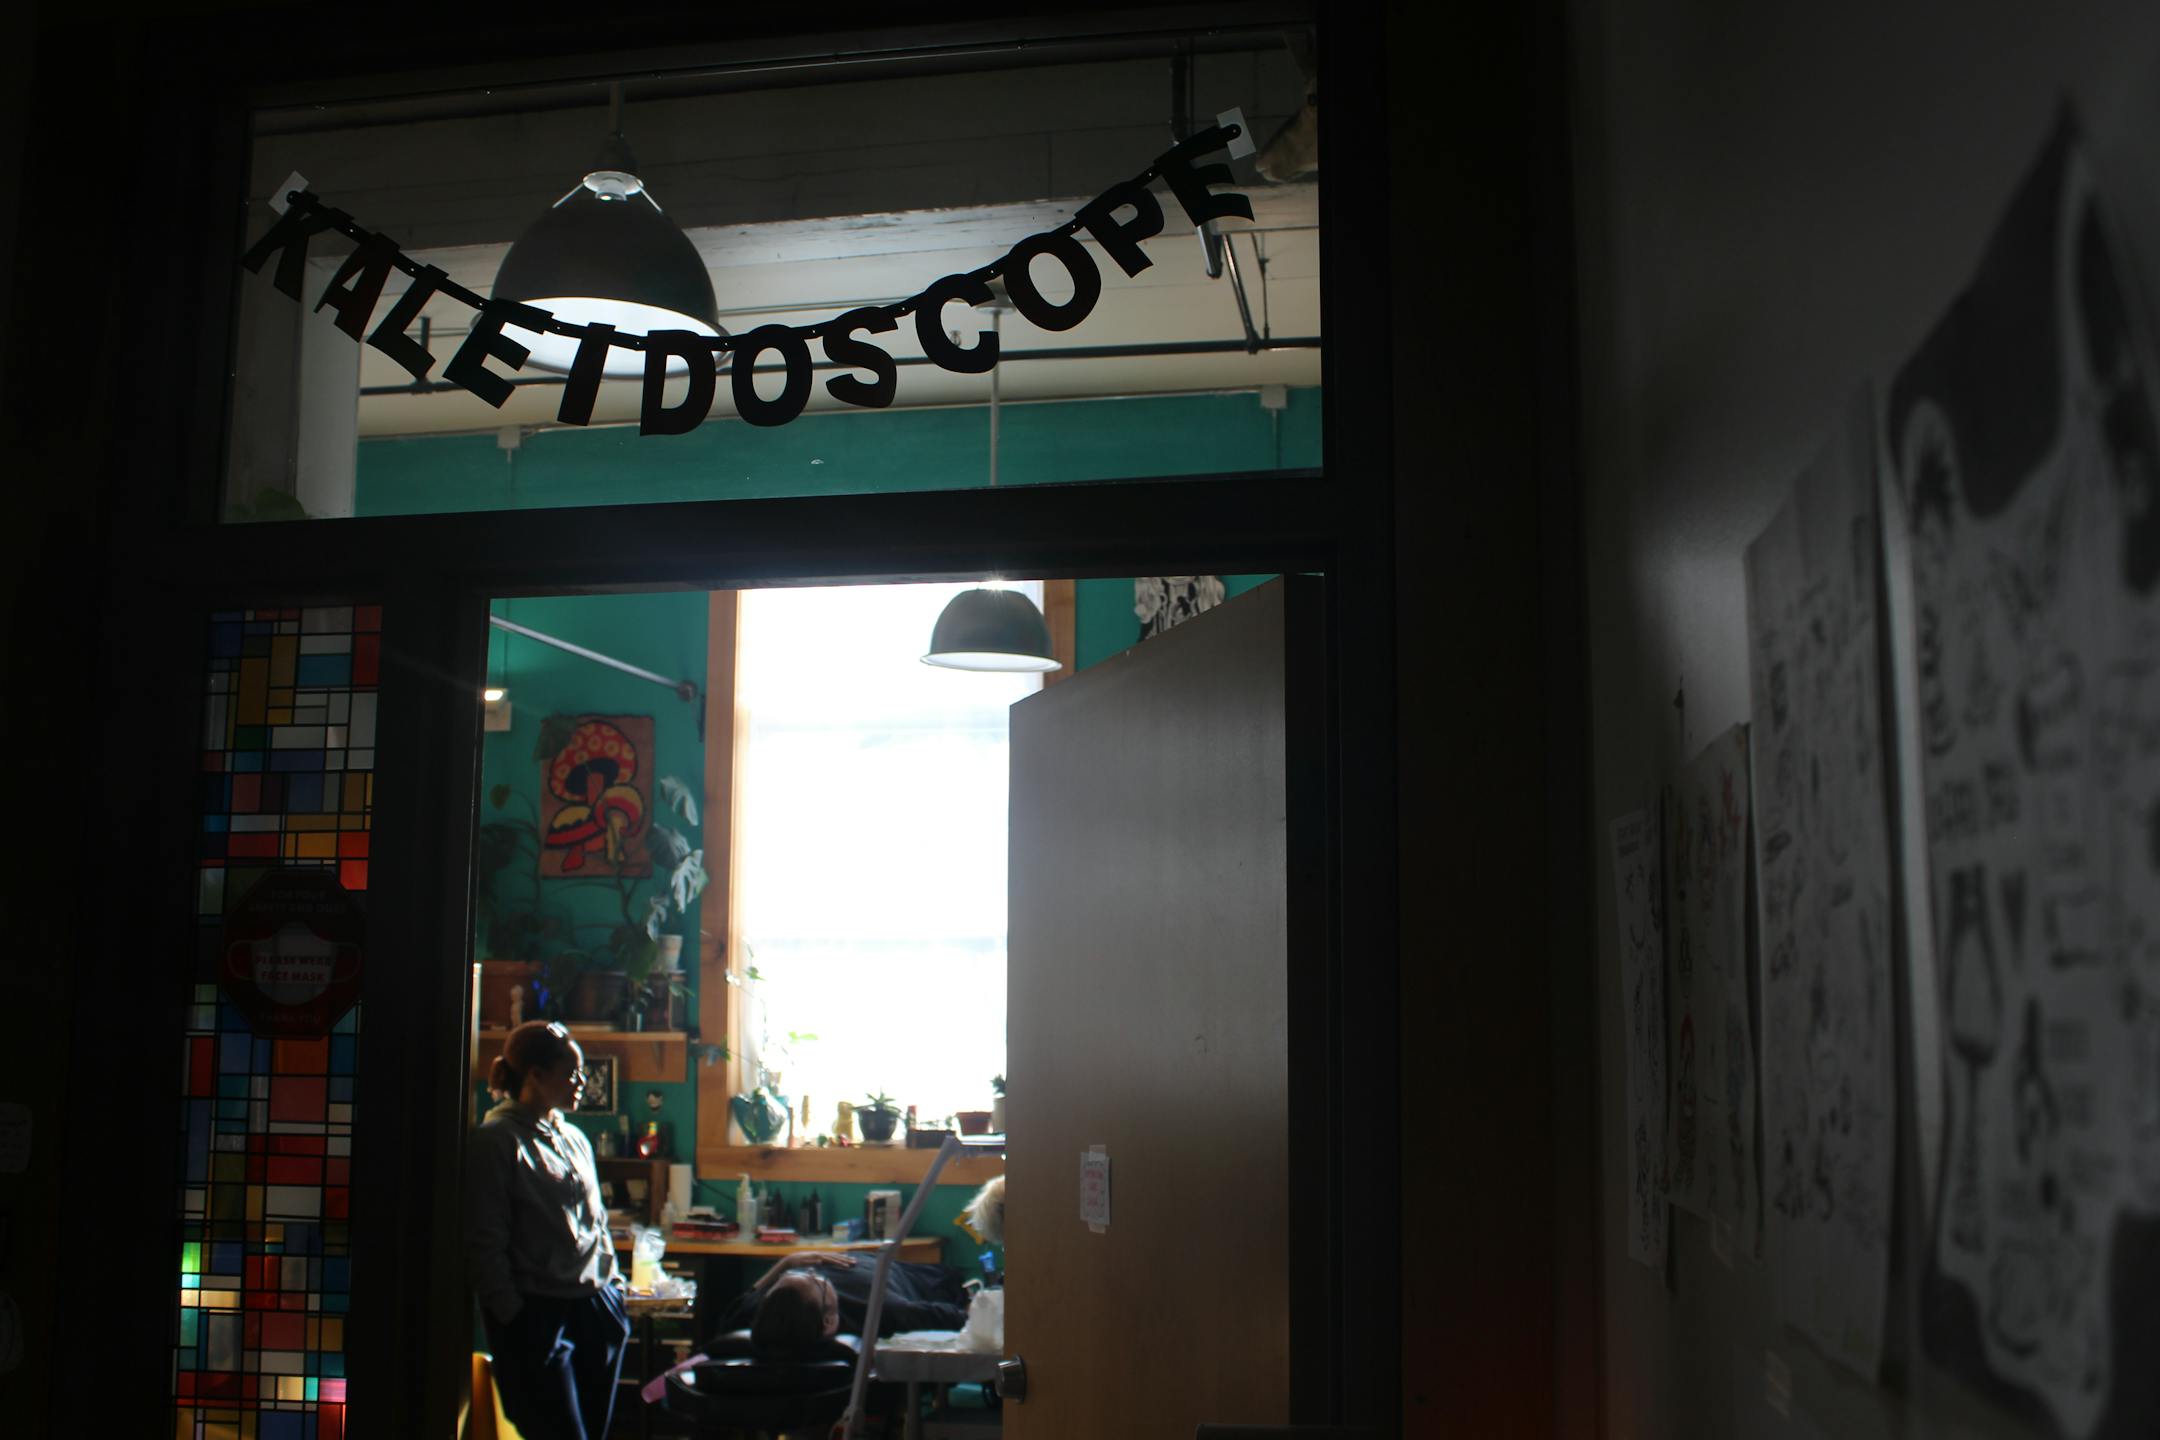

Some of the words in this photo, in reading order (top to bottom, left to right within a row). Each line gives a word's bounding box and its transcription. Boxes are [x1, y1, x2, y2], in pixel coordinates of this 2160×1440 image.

[241, 120, 1256, 436] KALEIDOSCOPE
[256, 955, 296, 966] PLEASE
[298, 955, 332, 967] WEAR
[261, 970, 288, 982] FACE
[291, 970, 325, 982] MASK
